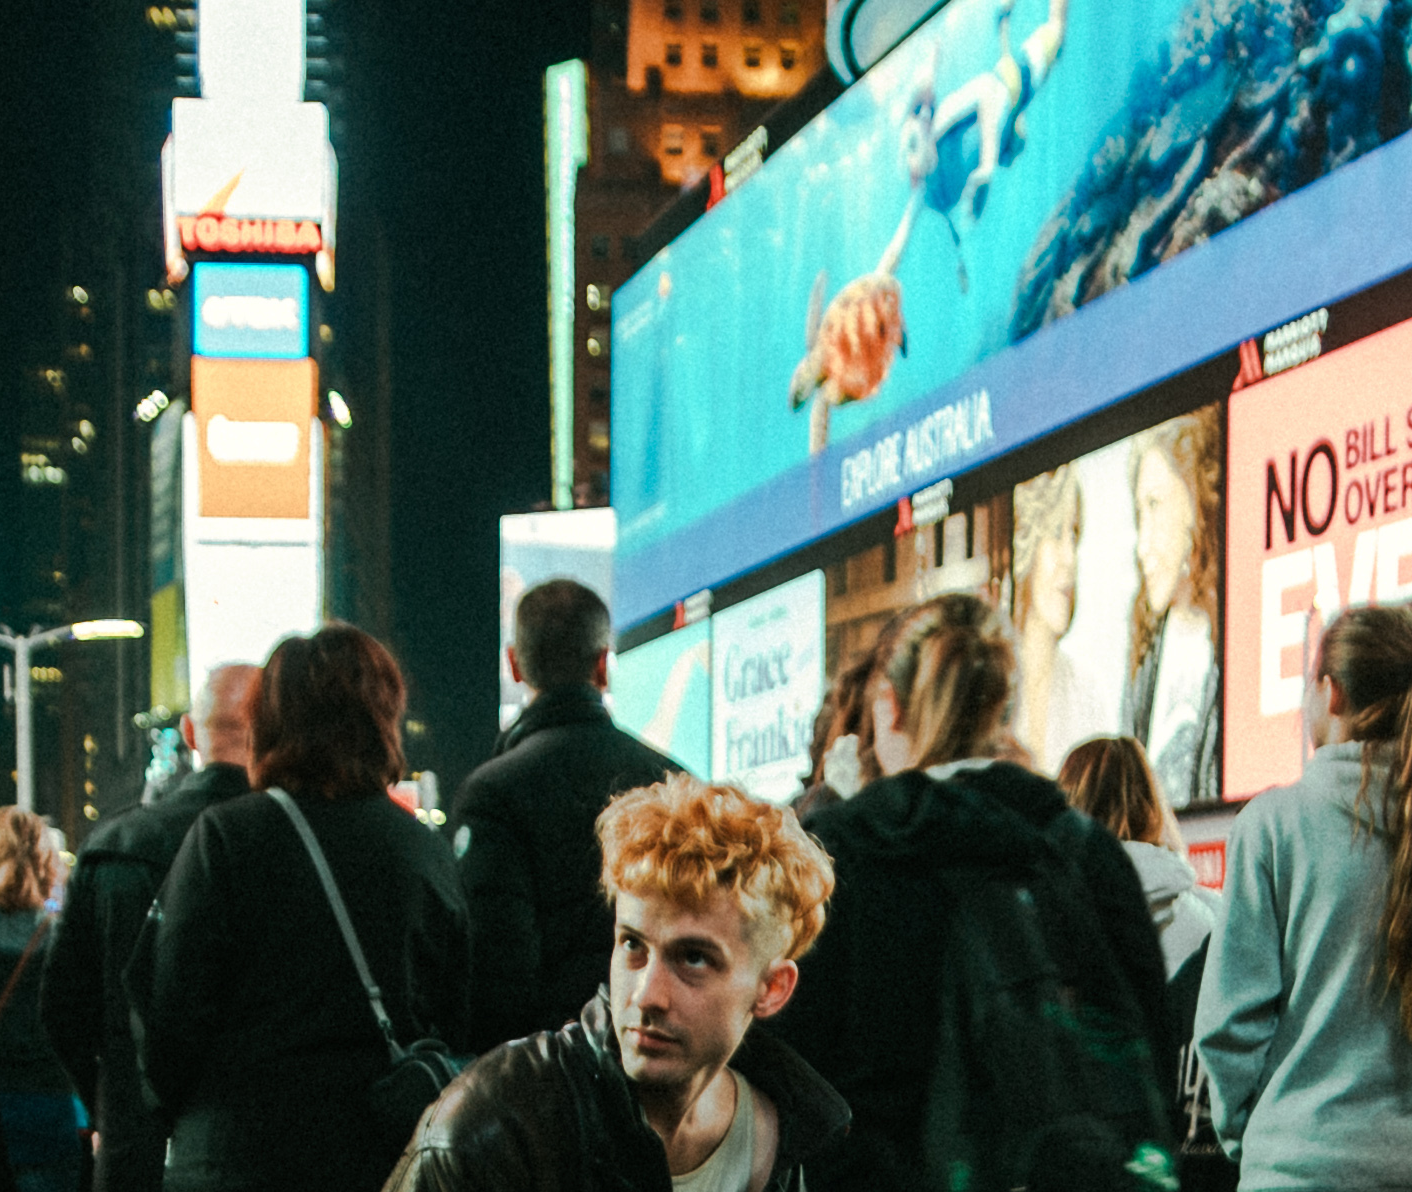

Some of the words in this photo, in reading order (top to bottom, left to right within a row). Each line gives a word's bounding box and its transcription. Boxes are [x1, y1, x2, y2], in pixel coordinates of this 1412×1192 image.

[176, 214, 322, 254] TOSHIBA
[903, 388, 994, 473] AUSTRALIA
[1264, 437, 1339, 550] NO
[1344, 415, 1396, 470] BILL
